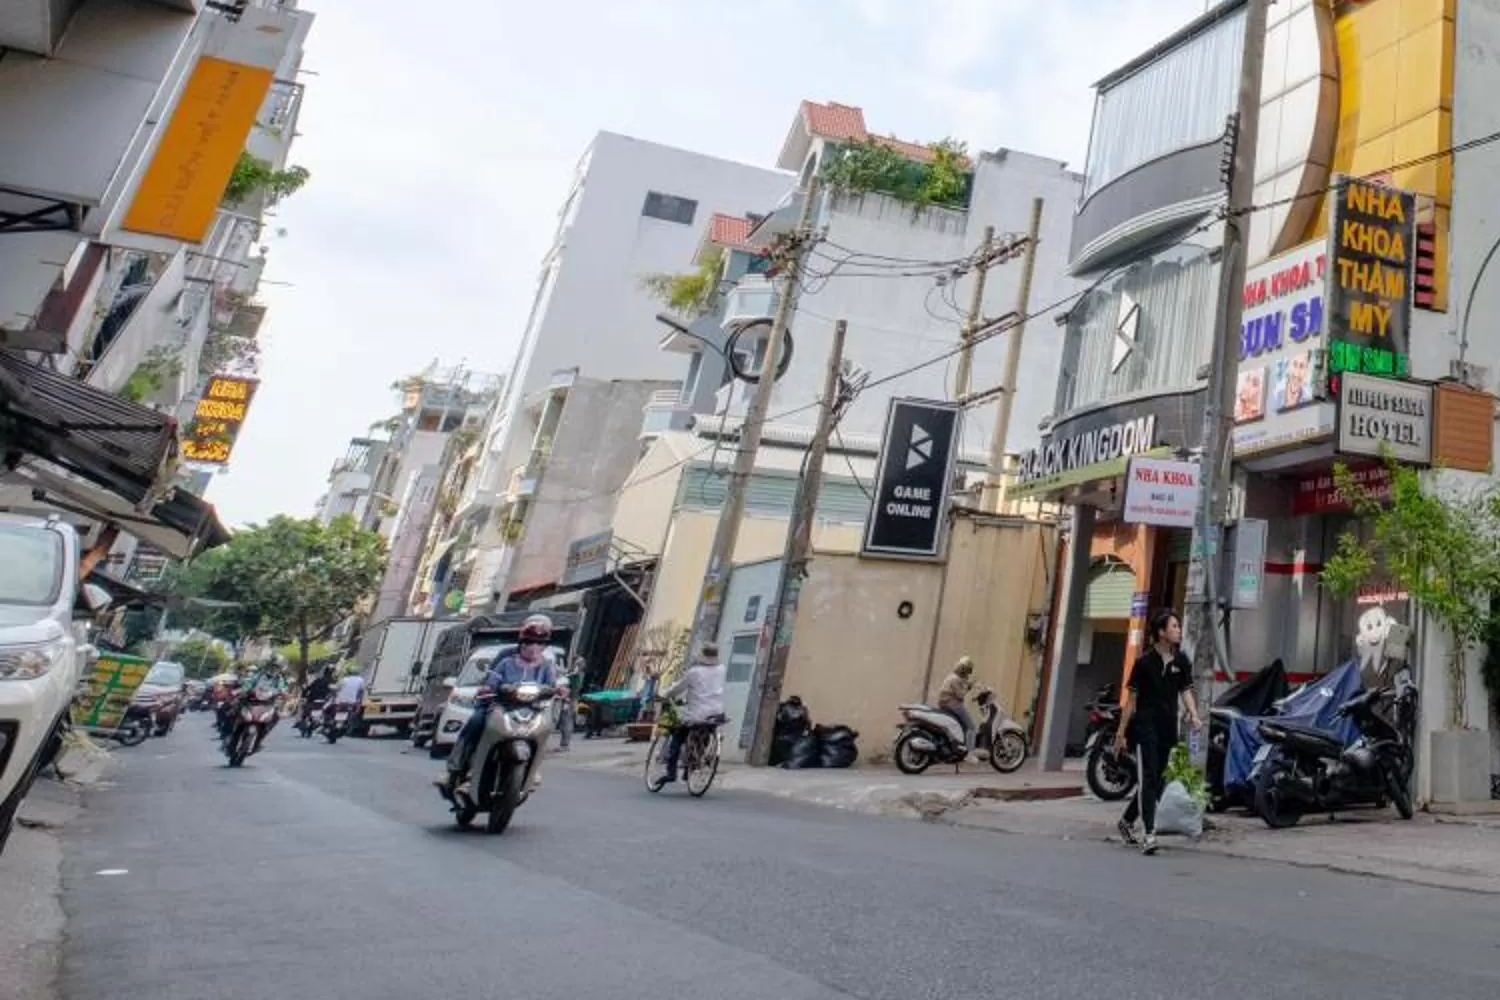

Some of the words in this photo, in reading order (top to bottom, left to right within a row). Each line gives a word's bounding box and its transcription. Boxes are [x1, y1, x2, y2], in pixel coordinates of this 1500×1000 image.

[1347, 184, 1405, 222] NHA
[1342, 219, 1406, 263] KHOA
[1018, 438, 1066, 483] BLACK
[1067, 414, 1157, 471] KINGDOM
[1135, 467, 1159, 485] NHA
[1162, 470, 1195, 488] KHOA
[893, 485, 932, 500] GAME
[886, 503, 933, 519] ONLINE
